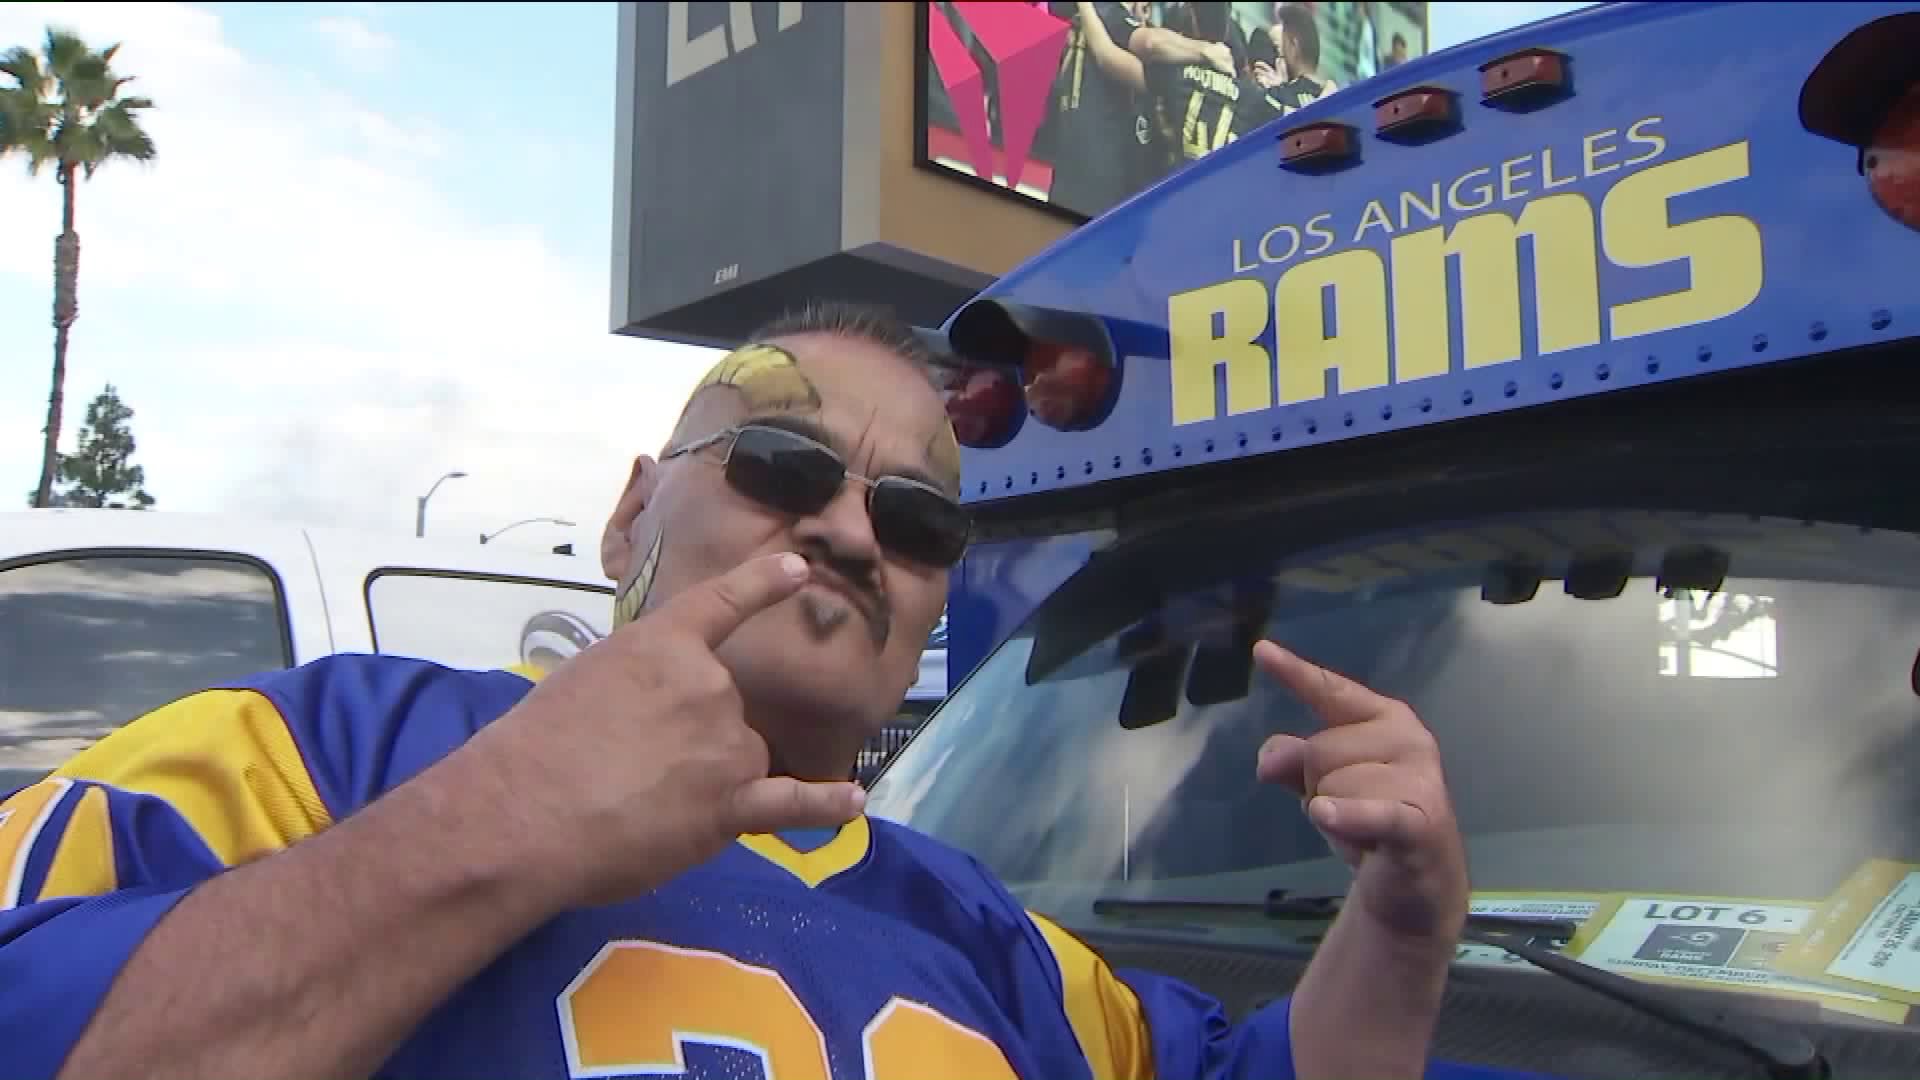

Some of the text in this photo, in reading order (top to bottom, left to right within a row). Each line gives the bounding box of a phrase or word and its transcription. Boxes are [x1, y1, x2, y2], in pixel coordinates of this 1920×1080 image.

[1232, 116, 1668, 274] LOS ANGELES
[1167, 140, 1764, 427] RAMS
[1644, 903, 1732, 921] LOT
[1737, 909, 1767, 925] 6
